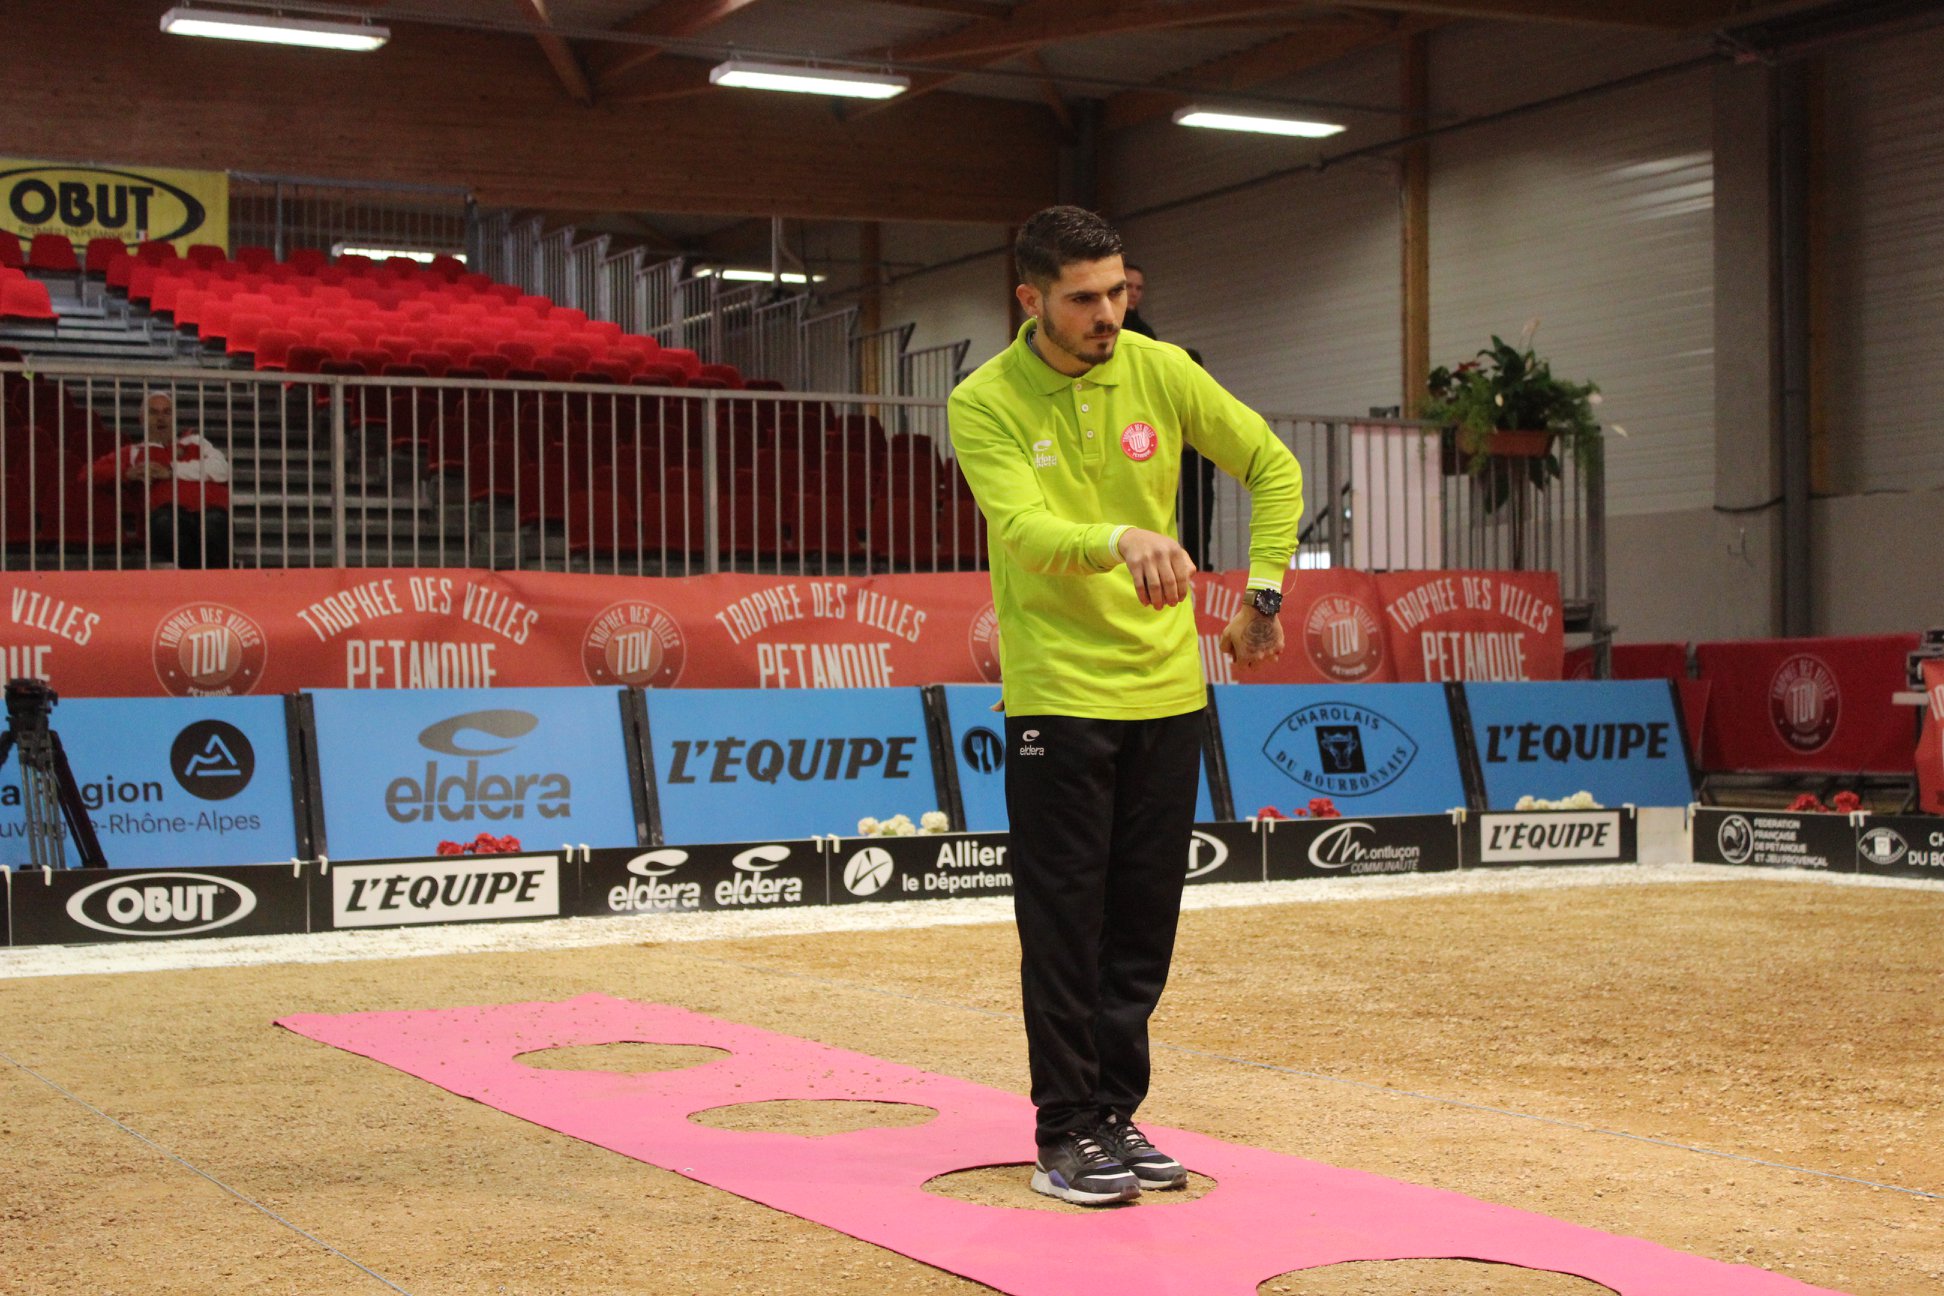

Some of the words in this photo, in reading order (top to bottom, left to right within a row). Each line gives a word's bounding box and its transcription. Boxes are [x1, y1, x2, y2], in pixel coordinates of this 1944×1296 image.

[9, 178, 154, 231] OBUT
[12, 587, 101, 646] VILLES
[297, 579, 403, 642] TROPHEE
[409, 576, 453, 616] DES
[462, 582, 540, 646] VILLES
[715, 583, 804, 645] TROPHEE
[810, 582, 848, 619] DES
[856, 588, 927, 643] VILLES
[1205, 580, 1241, 624] VILL
[1386, 577, 1458, 633] TROPHEE
[1462, 576, 1492, 611] DES
[1500, 582, 1553, 634] VILLES
[188, 627, 230, 677] TDV
[615, 629, 653, 676] TDV
[1328, 618, 1359, 658] TDV
[1421, 631, 1530, 682] PETANQUE
[347, 639, 497, 689] PETANQUE
[757, 642, 894, 689] PETANQUE
[1287, 708, 1380, 732] CHAROLAIS
[1019, 744, 1045, 756] eldera
[1276, 751, 1297, 772] DU
[1303, 746, 1408, 791] BOURBONNAIS
[385, 760, 571, 823] eldera
[936, 840, 1007, 869] Allier
[1908, 850, 1928, 866] DU
[107, 885, 219, 924] OBUT
[607, 876, 701, 912] eldera
[714, 871, 803, 906] eldera
[902, 873, 919, 892] le
[924, 871, 1014, 894] Départem
